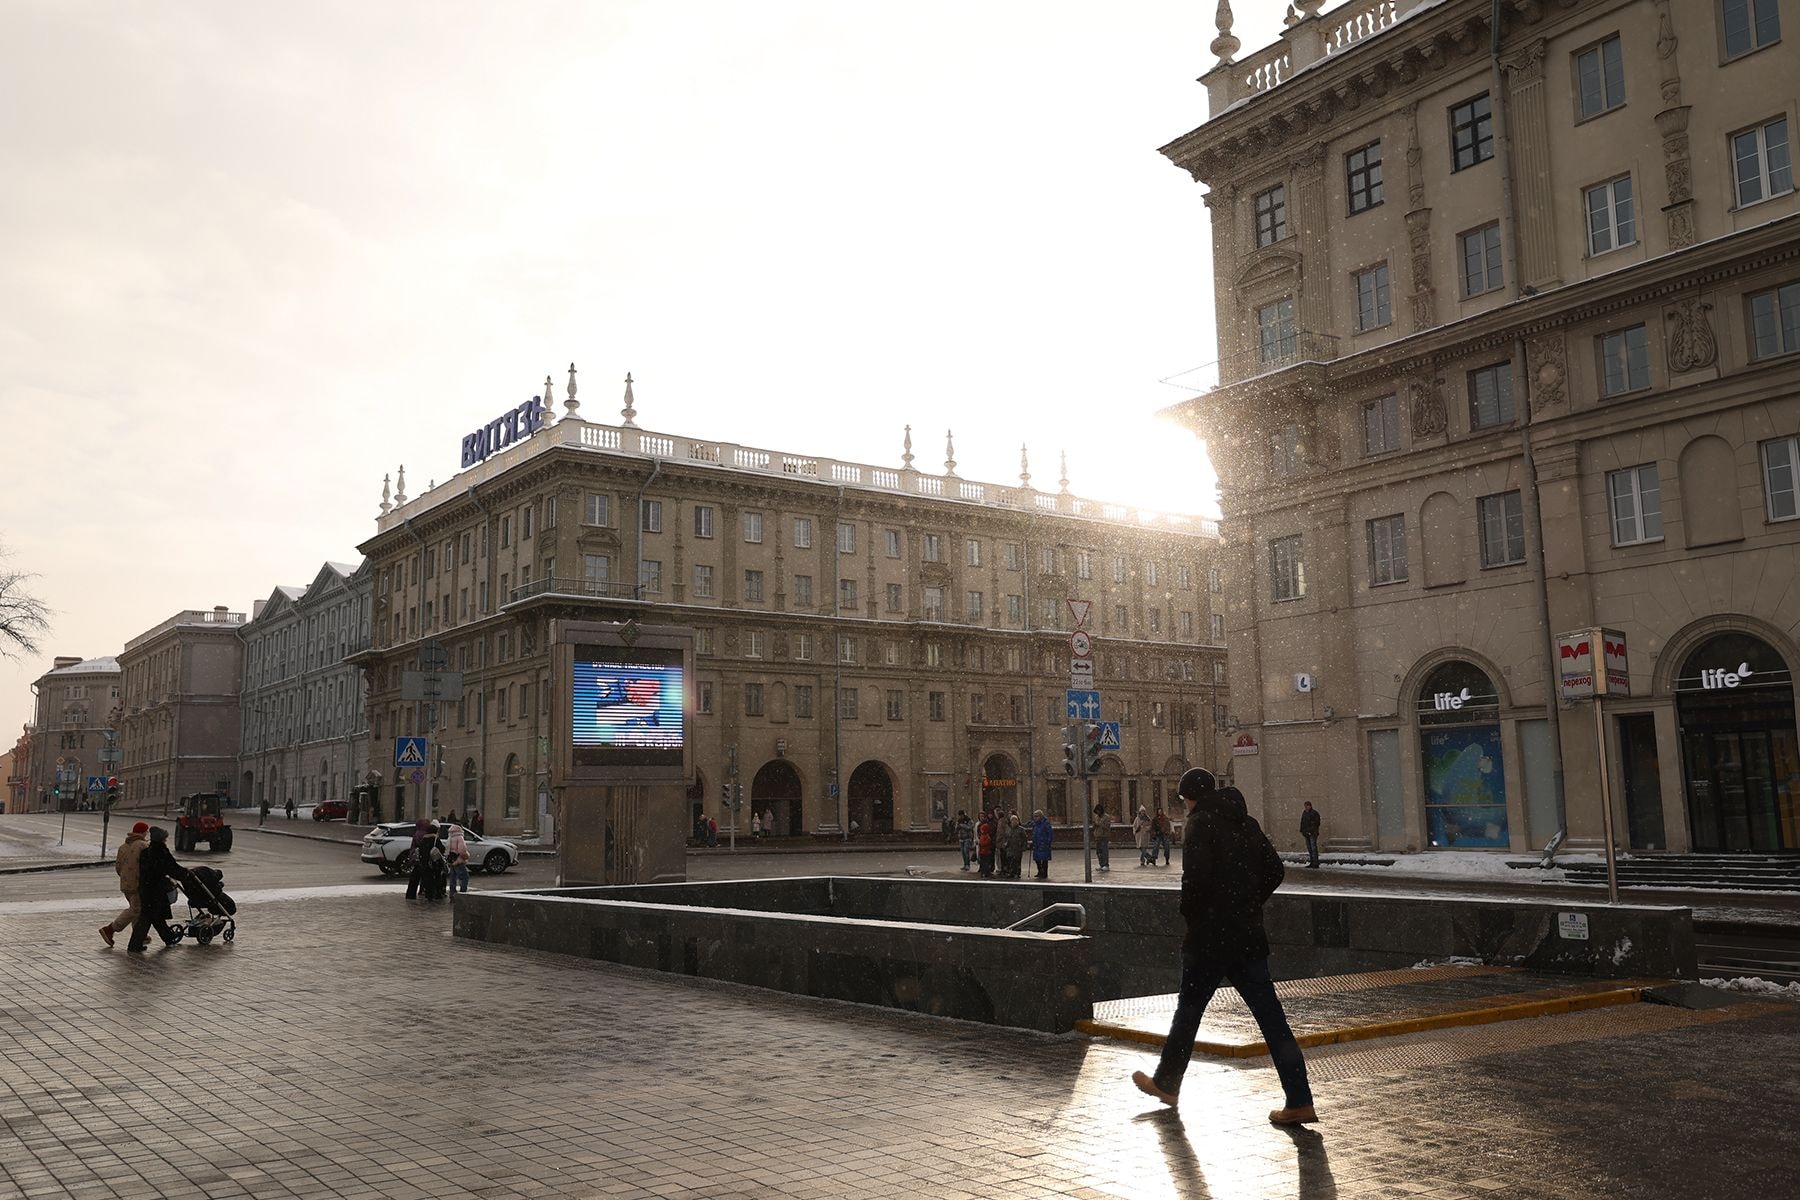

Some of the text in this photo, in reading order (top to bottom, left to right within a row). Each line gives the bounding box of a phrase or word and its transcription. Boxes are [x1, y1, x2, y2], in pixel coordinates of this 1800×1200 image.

[461, 395, 546, 468] ВИТЯЗЬ
[1563, 676, 1592, 688] переход
[1701, 668, 1740, 690] life
[1434, 692, 1463, 711] life
